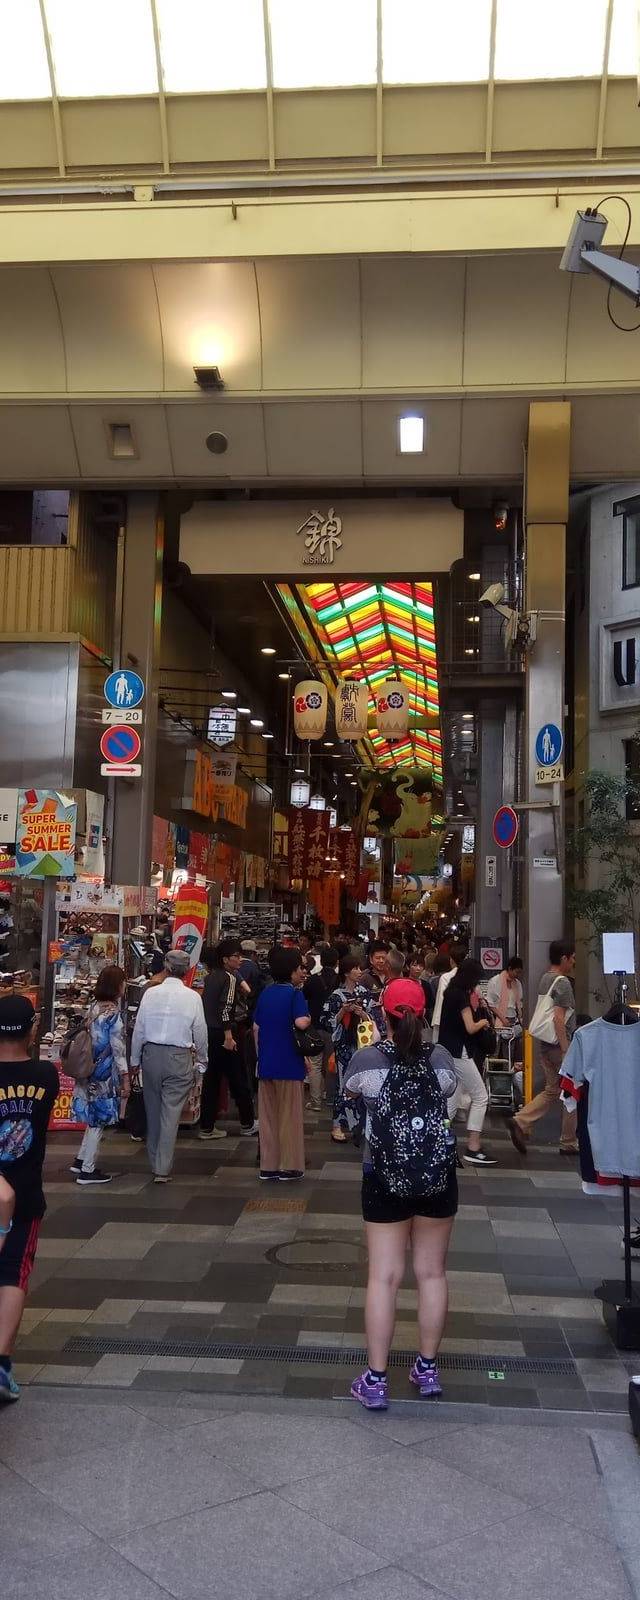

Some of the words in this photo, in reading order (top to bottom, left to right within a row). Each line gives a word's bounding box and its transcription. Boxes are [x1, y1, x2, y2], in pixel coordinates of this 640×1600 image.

[537, 769, 561, 780] 10-24
[22, 814, 56, 825] SUPER
[27, 824, 72, 835] SUMMER
[20, 835, 71, 852] SALE
